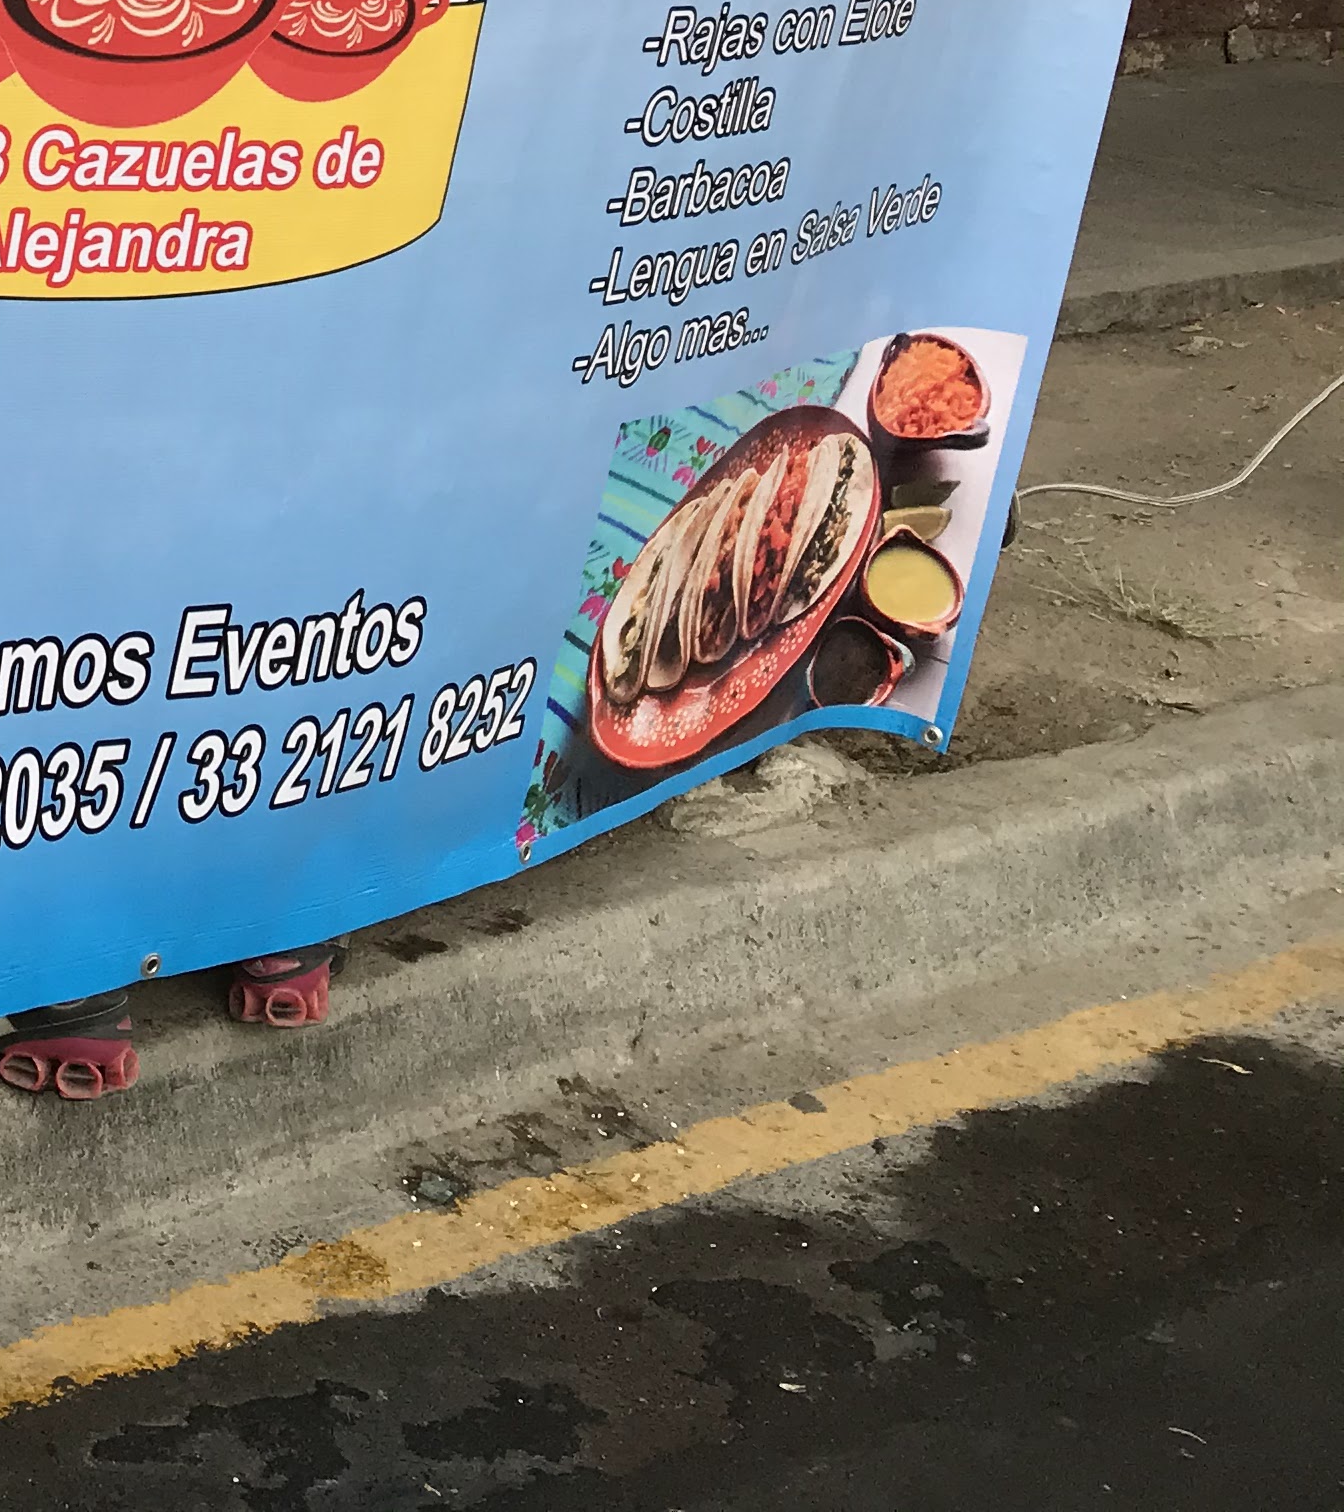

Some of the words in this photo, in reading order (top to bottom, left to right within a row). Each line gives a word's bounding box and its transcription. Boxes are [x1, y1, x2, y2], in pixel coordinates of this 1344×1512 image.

[642, 3, 766, 77] -Rajas
[772, 4, 835, 52] con
[624, 77, 776, 147] -Costilla
[23, 126, 302, 191] Cazuelas
[312, 125, 384, 189] de
[606, 157, 790, 229] -Barbacoa
[589, 237, 734, 308] -Lengua
[745, 233, 784, 276] en
[792, 200, 861, 265] Salsa
[866, 174, 943, 235] Verde
[572, 313, 670, 388] -Algo
[676, 300, 769, 364] mas...
[167, 588, 427, 701] Eventos
[131, 734, 169, 828] /
[178, 725, 264, 822] 33
[270, 695, 413, 810] 2121
[419, 658, 537, 773] 8252
